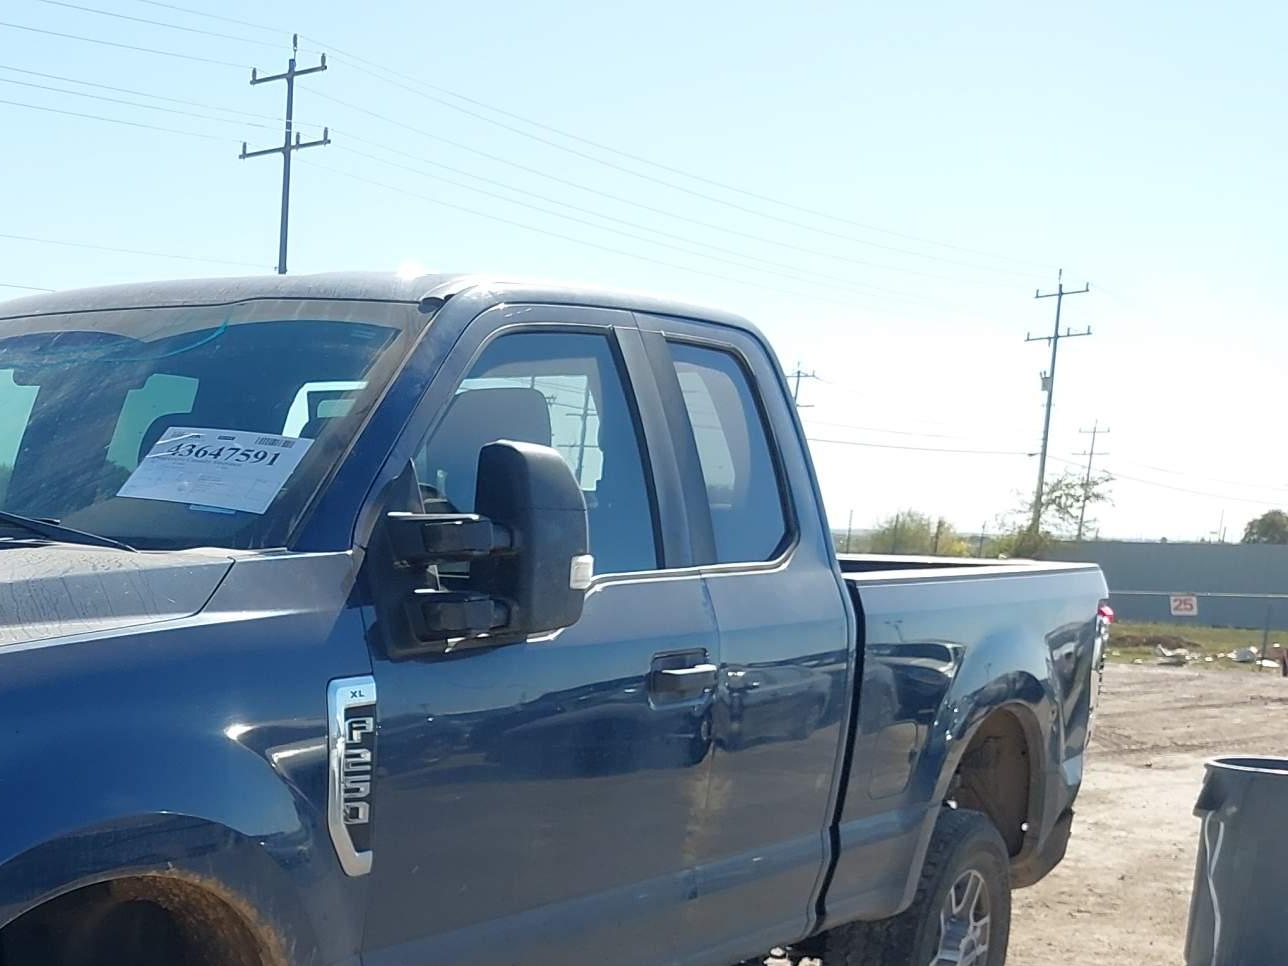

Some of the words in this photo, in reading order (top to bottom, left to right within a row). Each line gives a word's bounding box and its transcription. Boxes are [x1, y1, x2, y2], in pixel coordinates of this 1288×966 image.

[168, 442, 281, 466] 43647591
[1173, 597, 1194, 612] 25
[350, 689, 365, 699] XL
